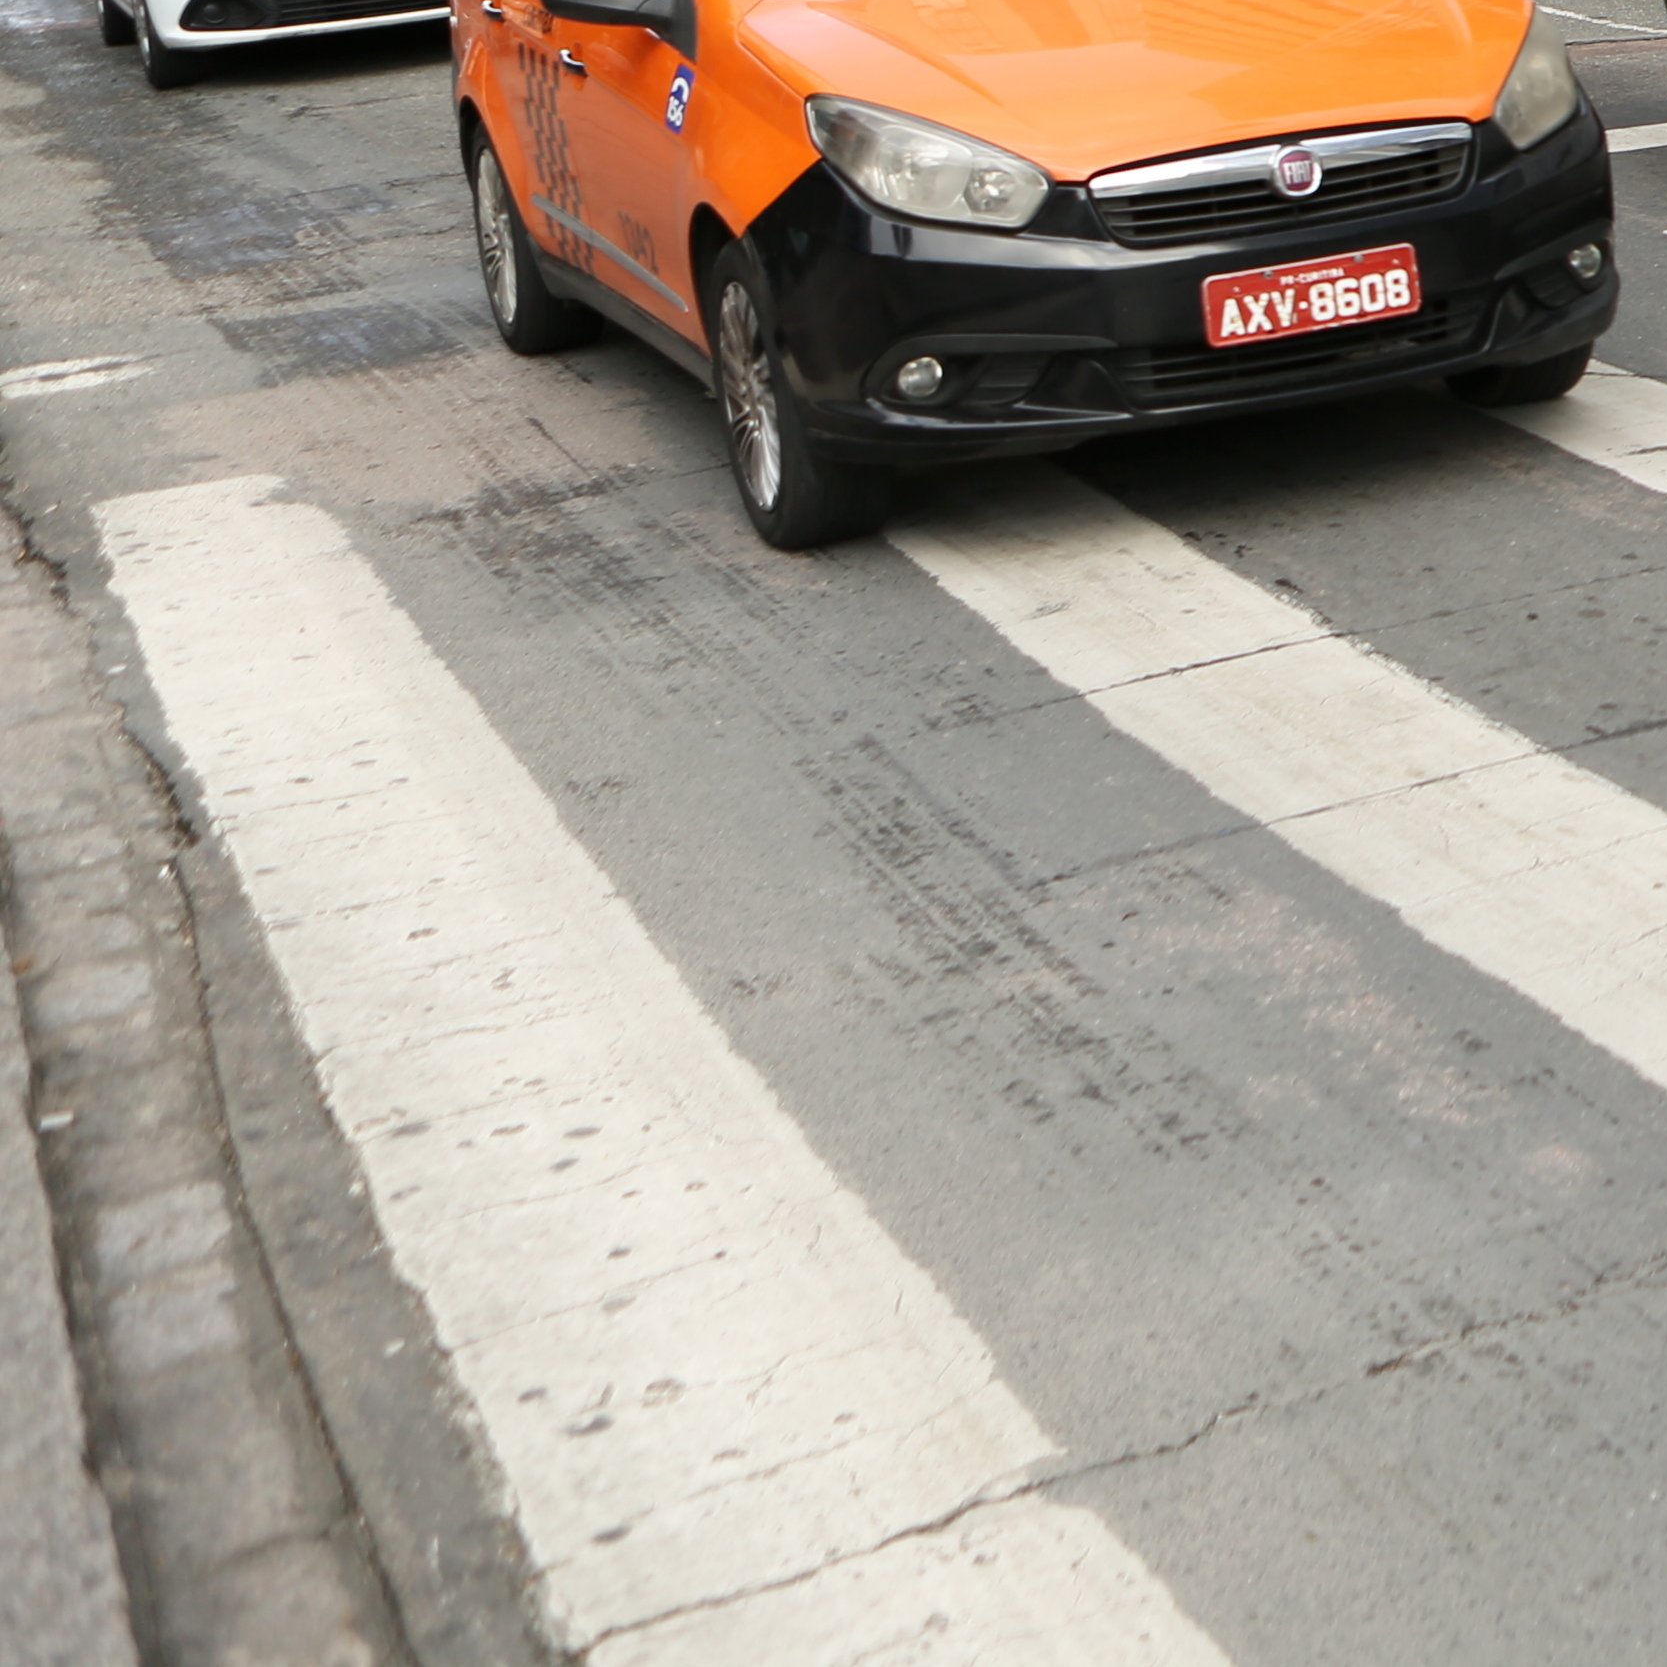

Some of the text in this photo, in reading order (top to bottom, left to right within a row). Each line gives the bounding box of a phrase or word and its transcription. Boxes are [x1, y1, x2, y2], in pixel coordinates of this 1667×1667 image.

[666, 95, 684, 128] 156
[1282, 160, 1314, 184] FIAT
[1279, 267, 1346, 287] PR-CURITIBA
